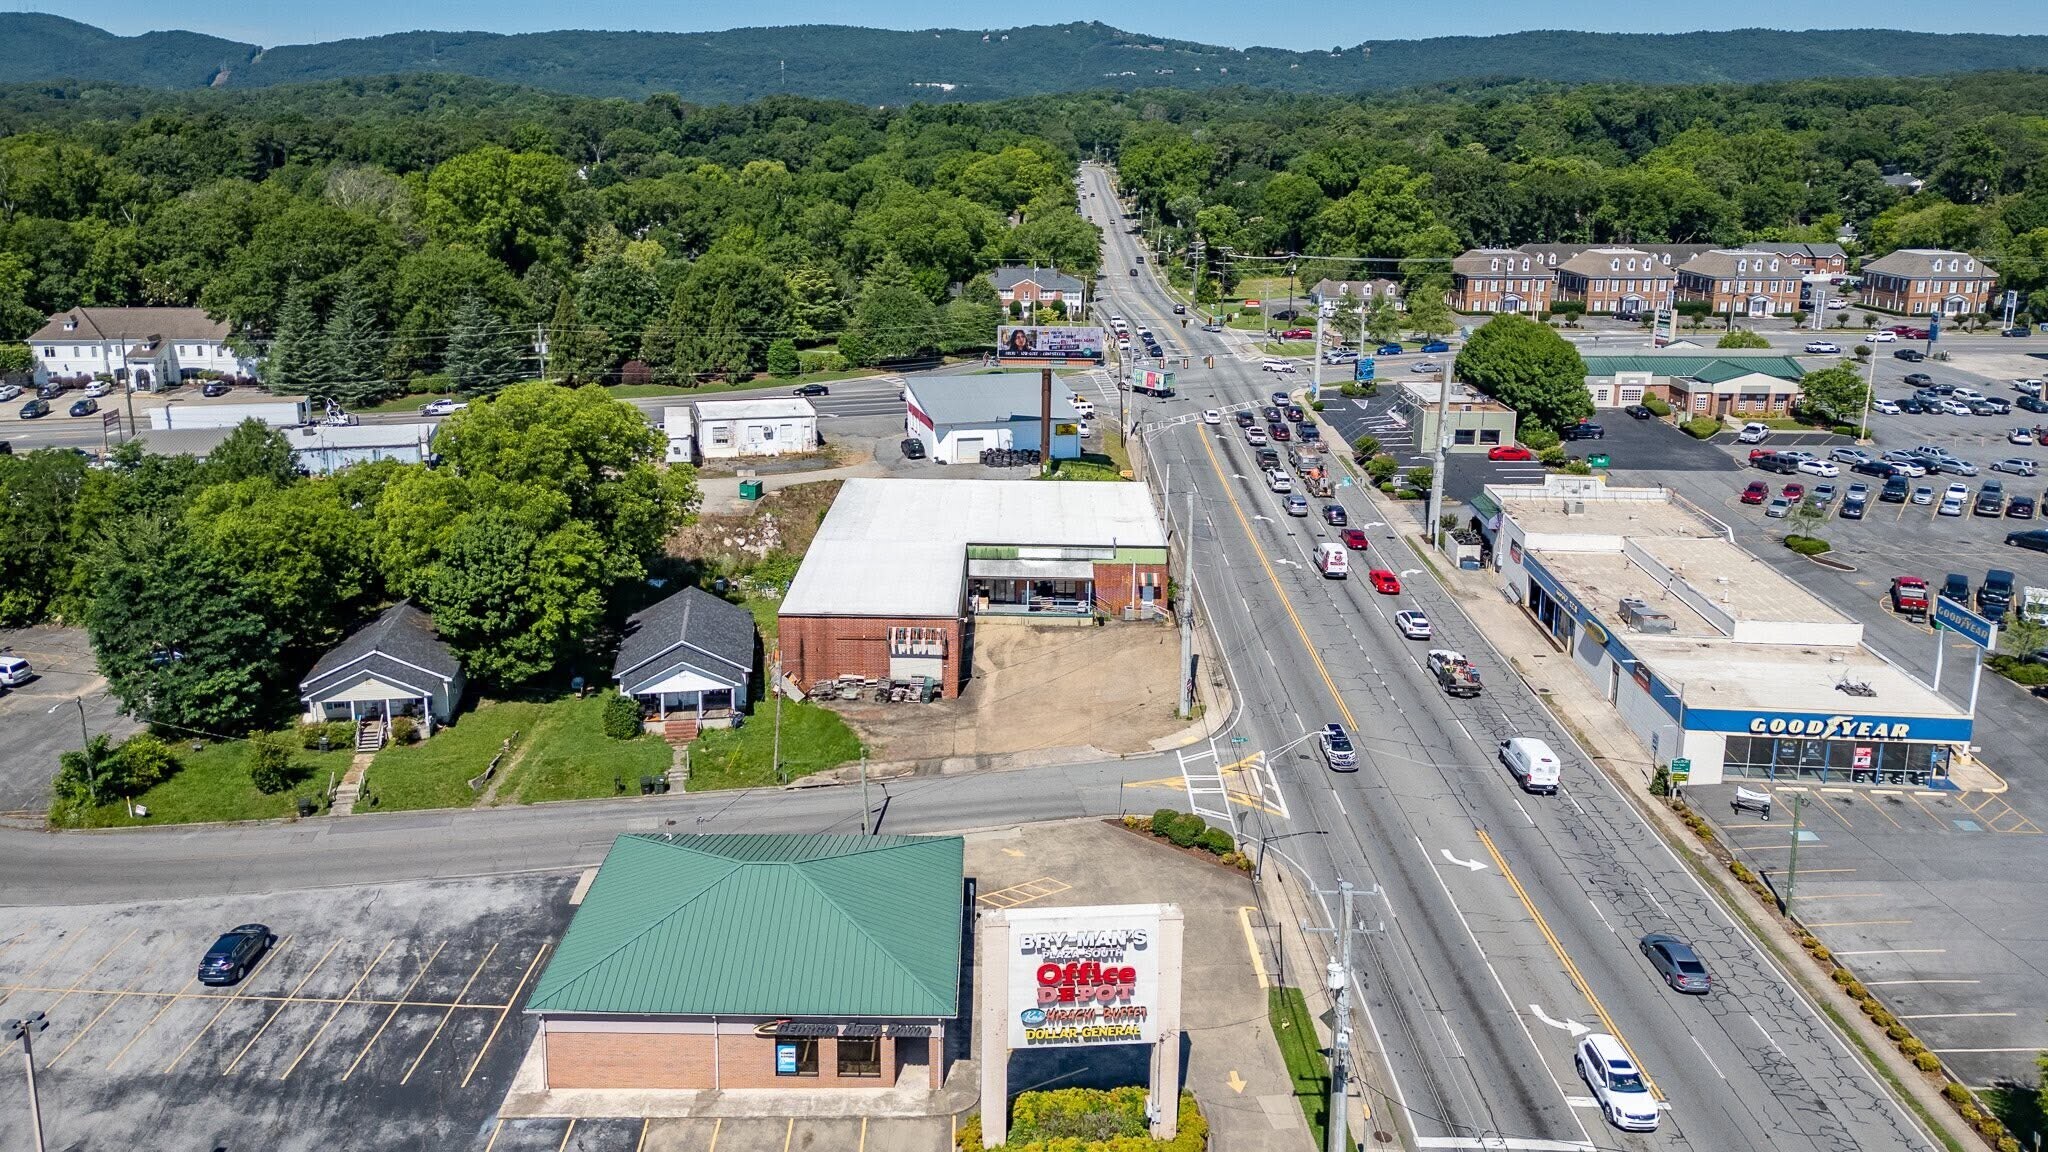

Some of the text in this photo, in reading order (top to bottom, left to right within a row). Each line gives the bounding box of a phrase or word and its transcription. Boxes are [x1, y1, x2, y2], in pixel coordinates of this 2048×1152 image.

[1938, 606, 1989, 639] GOODYEAR
[1750, 716, 1909, 739] GOODYEAR
[1020, 929, 1148, 951] BRY-MAN'S
[1042, 946, 1123, 959] PLAZA SOUTH
[1036, 961, 1136, 986] Office
[1037, 984, 1135, 1004] DEPOT
[1103, 1005, 1148, 1020] BUFFET
[1025, 1024, 1142, 1040] DOLLAR GENERAL
